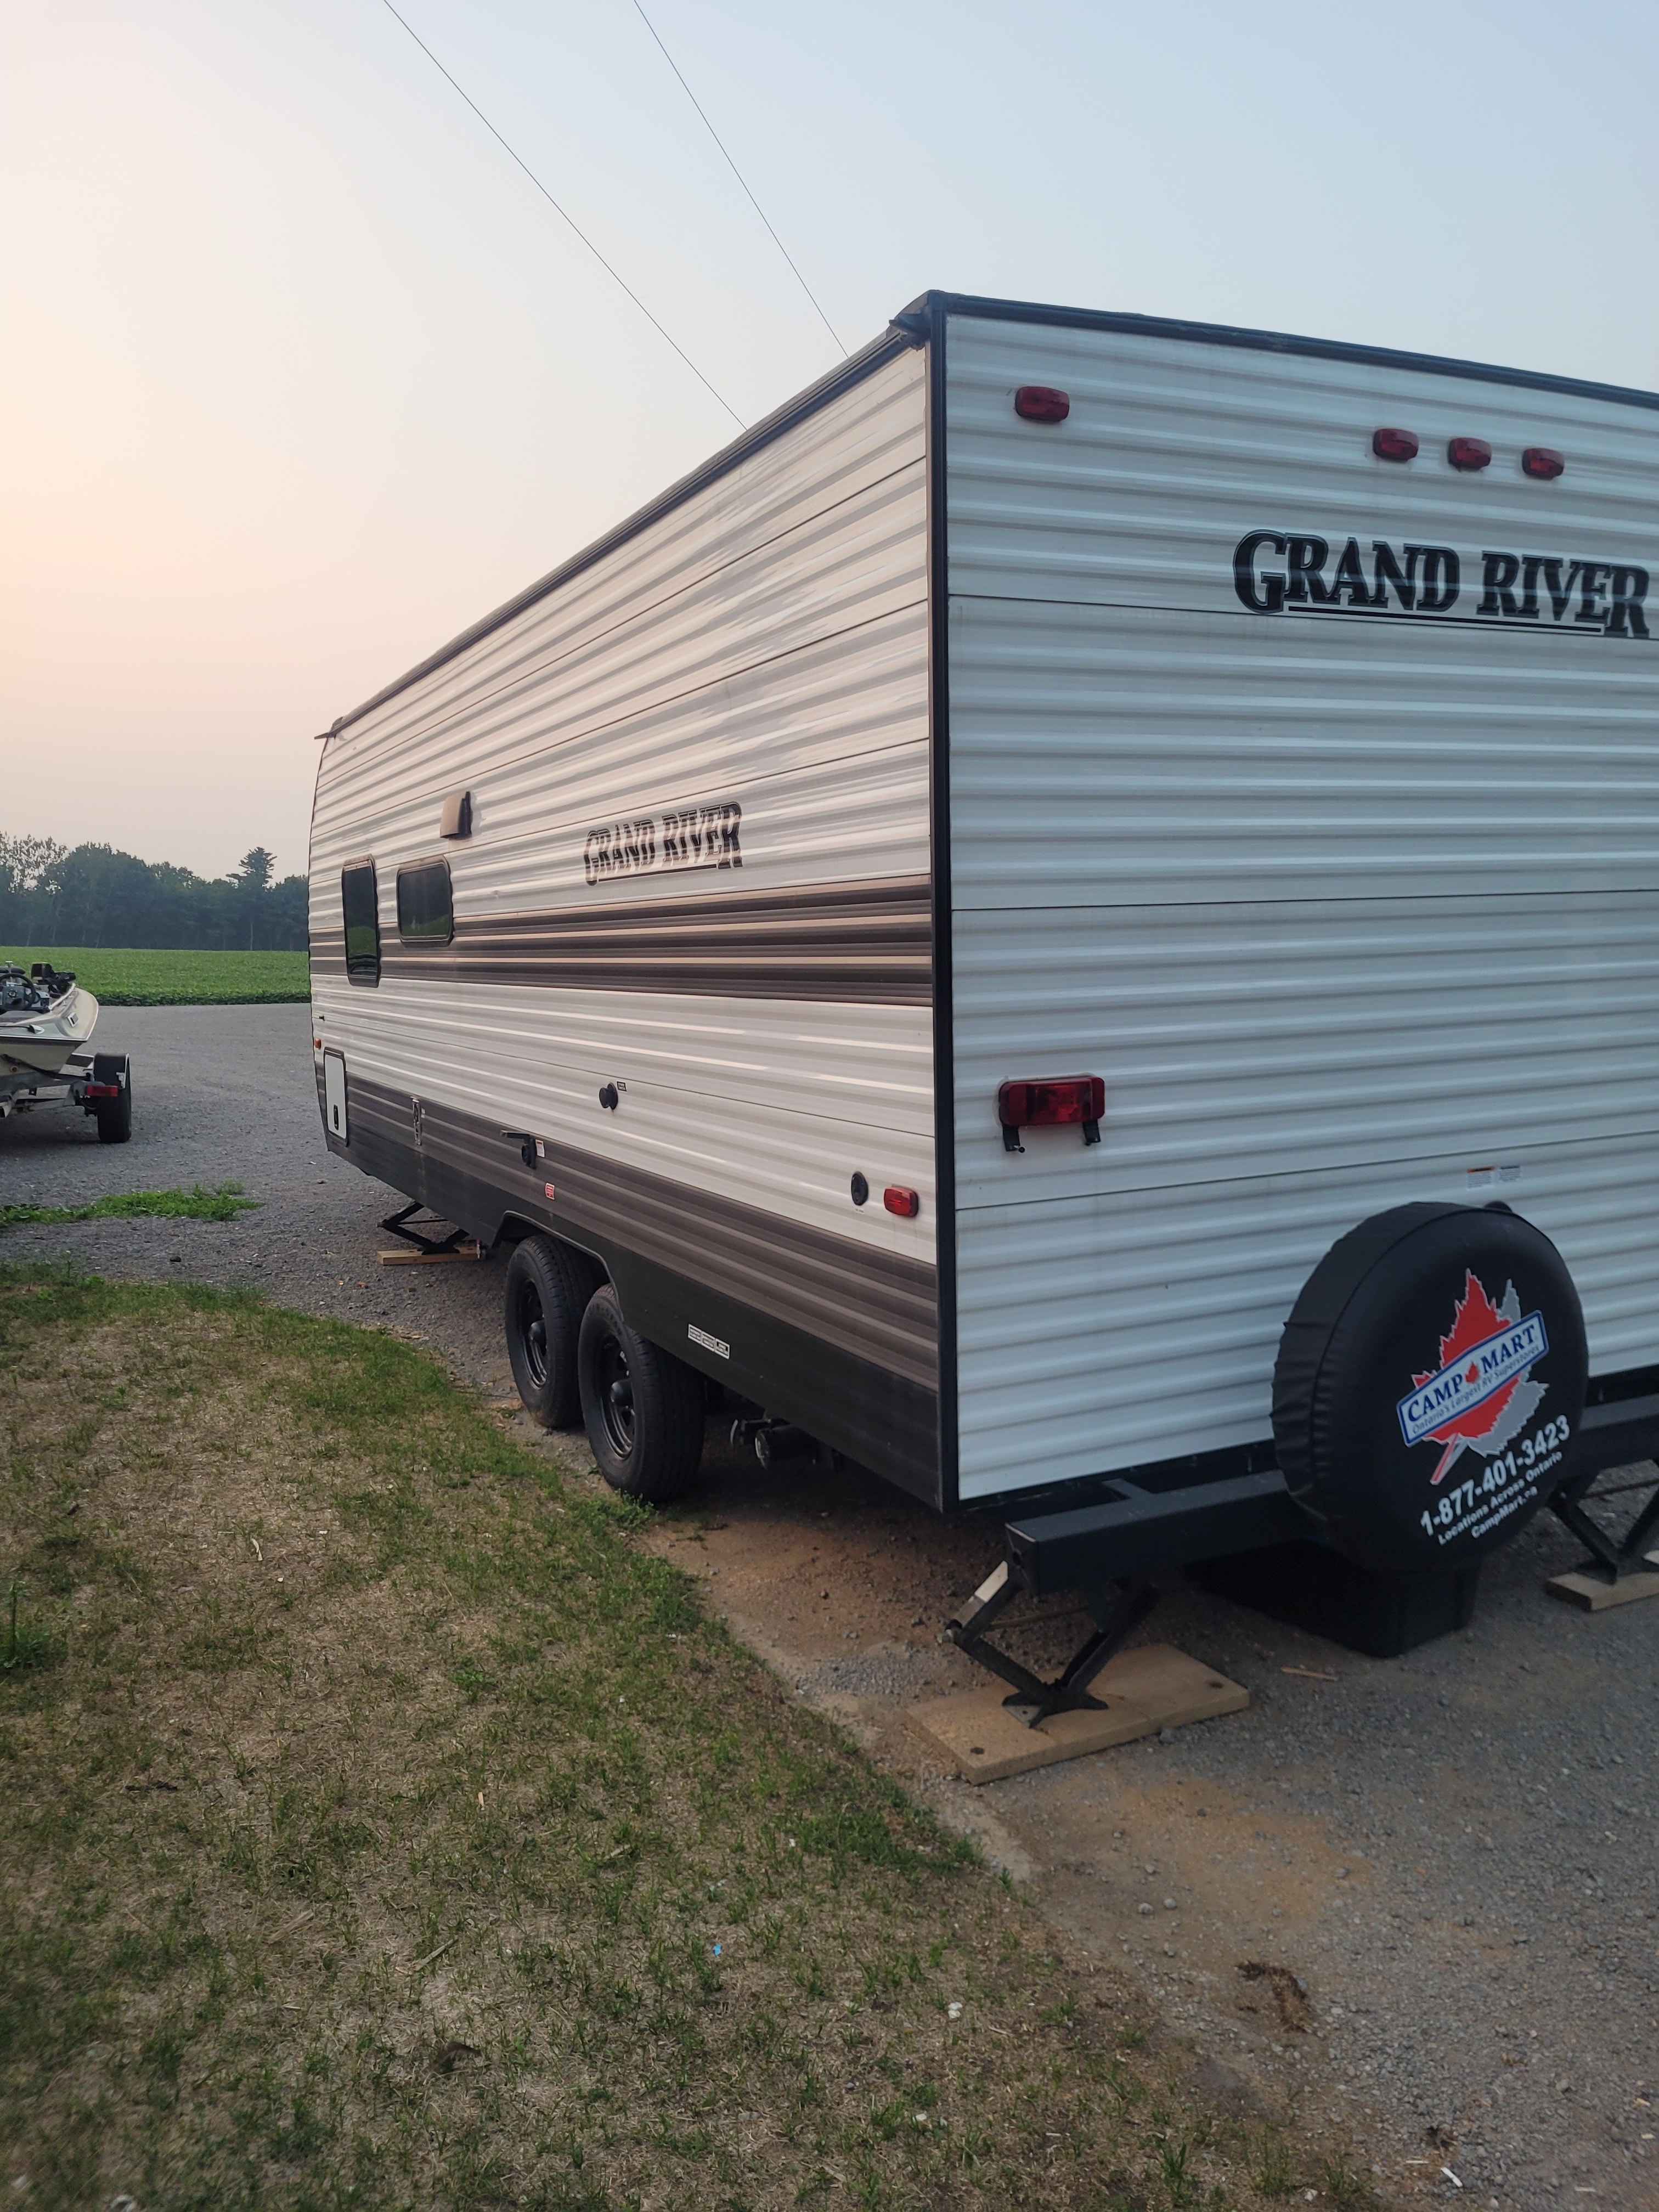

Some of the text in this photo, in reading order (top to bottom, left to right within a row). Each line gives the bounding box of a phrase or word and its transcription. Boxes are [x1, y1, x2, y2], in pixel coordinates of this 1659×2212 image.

[1233, 528, 1650, 639] GRAND RIVER
[584, 802, 743, 886] GRAND RIVER
[1408, 1324, 1535, 1421] CAMP MART
[1479, 1373, 1493, 1389] RV
[1420, 1414, 1570, 1536] 1-877-401-3423
[1438, 1451, 1562, 1545] Locations Across Ontario
